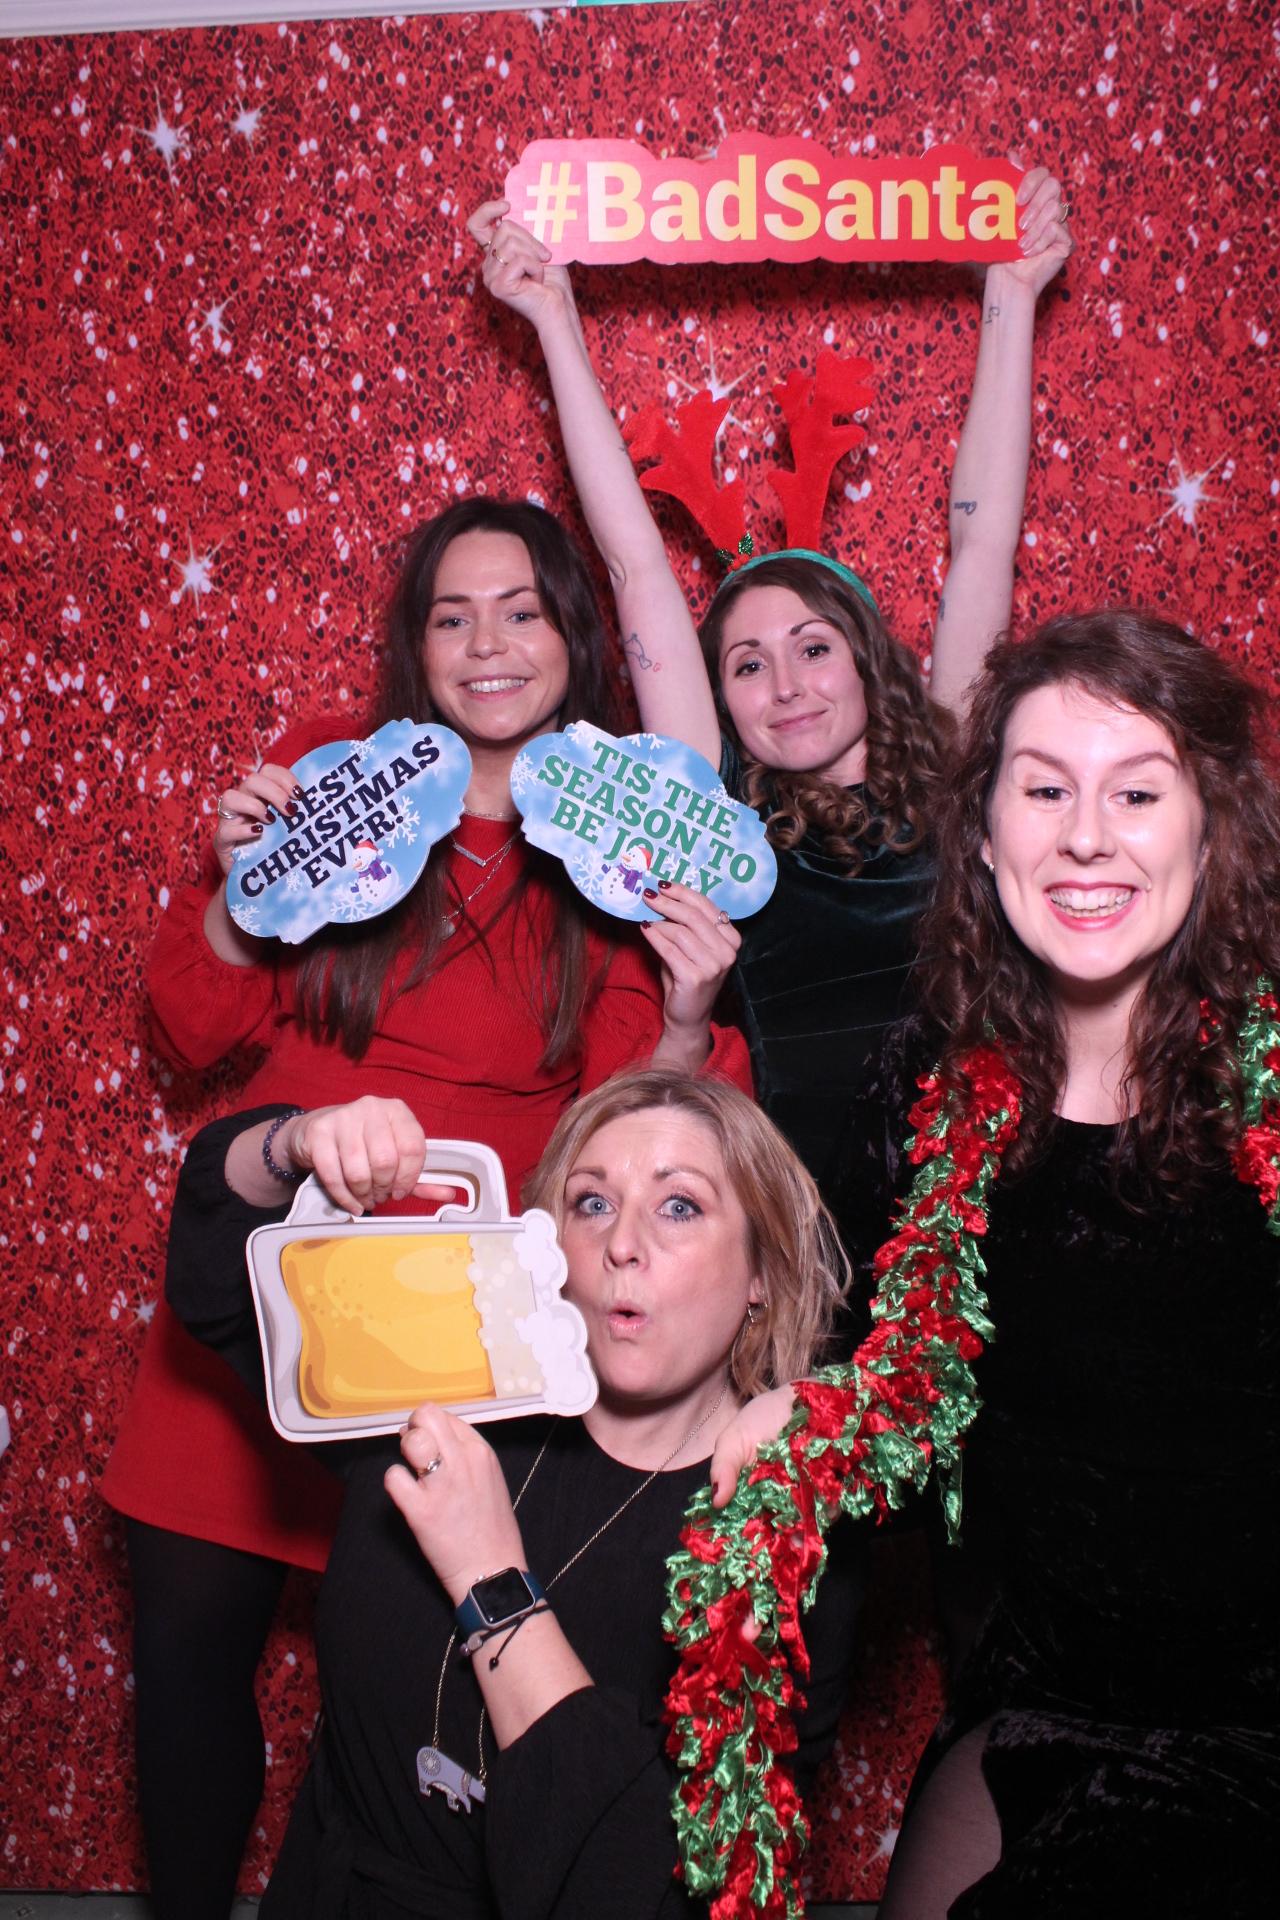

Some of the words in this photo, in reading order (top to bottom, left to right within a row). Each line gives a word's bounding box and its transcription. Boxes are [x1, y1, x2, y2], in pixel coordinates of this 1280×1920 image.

[523, 153, 1018, 244] #BadSanta
[240, 735, 441, 898] CHRISTMAS
[277, 753, 365, 834] BEST
[537, 754, 702, 855] SEASON
[707, 838, 757, 884] TO
[550, 796, 606, 845] BE
[591, 741, 657, 795] TIS
[663, 778, 739, 839] THE
[301, 799, 404, 889] EVER!
